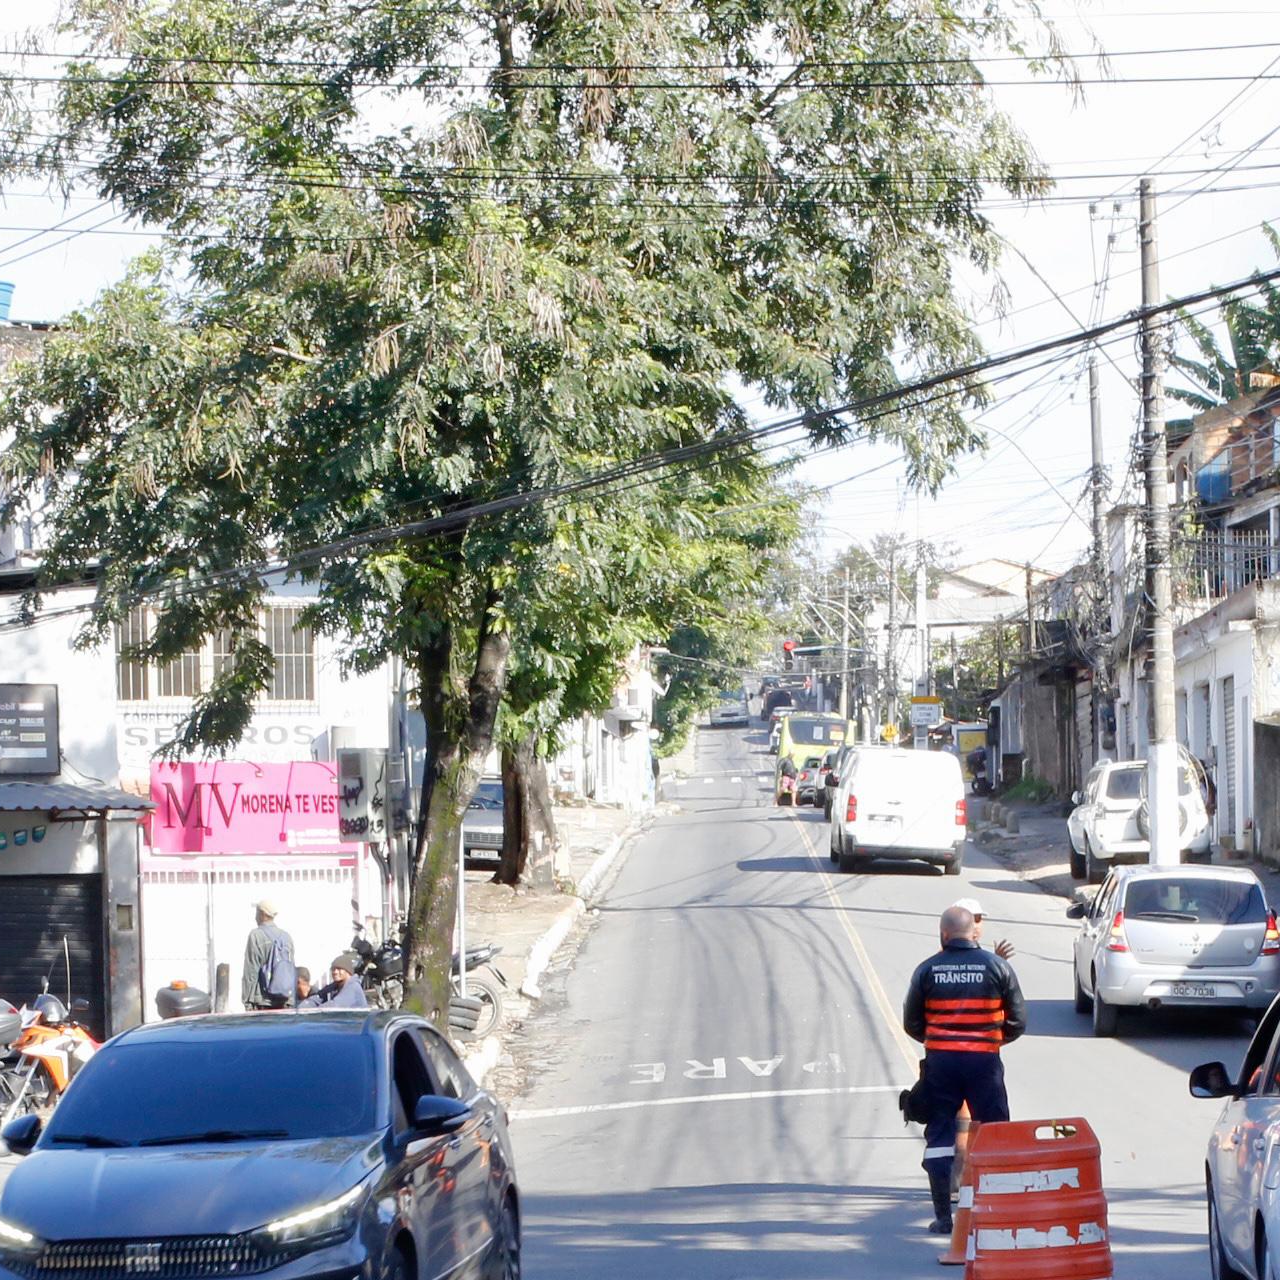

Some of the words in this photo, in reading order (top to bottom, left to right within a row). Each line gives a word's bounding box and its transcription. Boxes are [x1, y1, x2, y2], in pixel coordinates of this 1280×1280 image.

[161, 782, 243, 829] MV
[241, 794, 293, 813] MORENA
[295, 794, 310, 813] TE
[934, 971, 984, 984] TRÂNSITO
[628, 1053, 847, 1085] PARE
